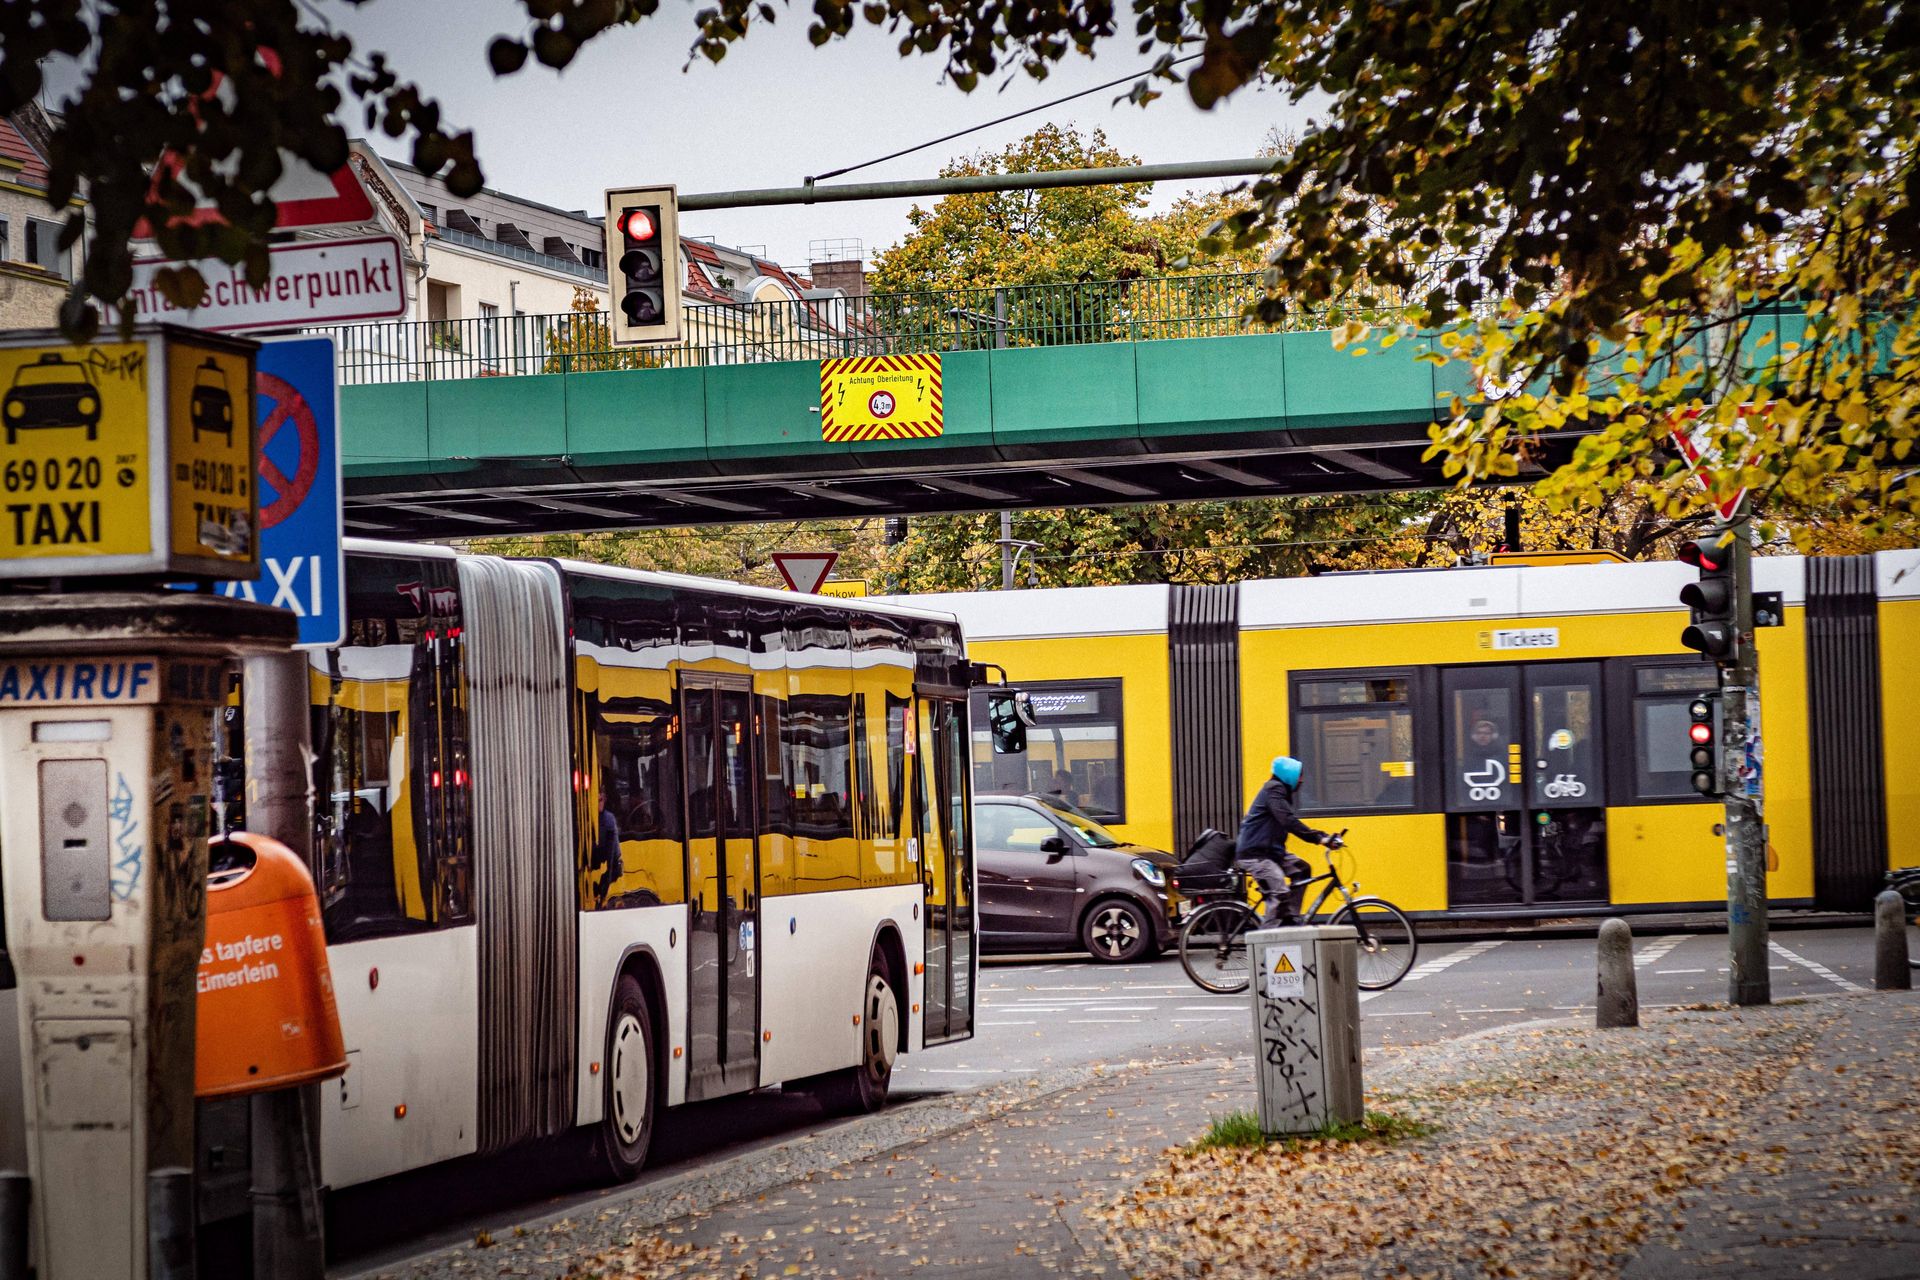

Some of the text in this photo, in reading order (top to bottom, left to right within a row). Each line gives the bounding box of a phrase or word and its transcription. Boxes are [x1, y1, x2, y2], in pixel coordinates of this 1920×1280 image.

[130, 257, 392, 314] nfaschwerpunkt
[849, 374, 914, 386] Achtung Oberleitung
[6, 501, 101, 545] TAXI
[1498, 632, 1554, 648] Tickets
[215, 934, 283, 962] tapfere
[196, 960, 279, 993] Eimerlein
[1271, 975, 1301, 985] 22509
